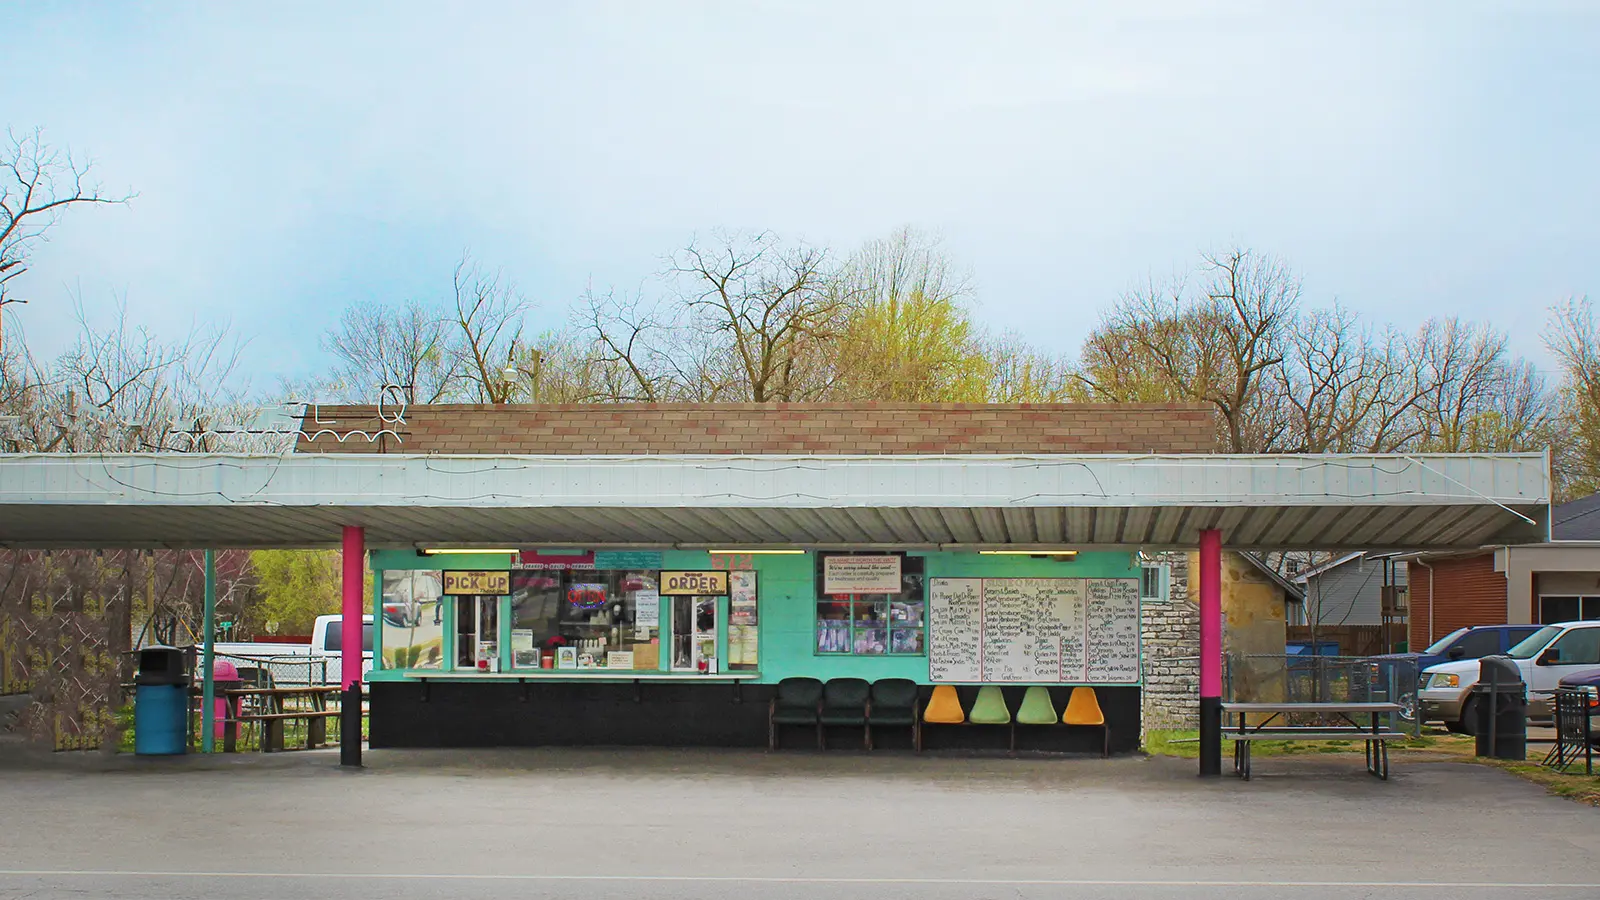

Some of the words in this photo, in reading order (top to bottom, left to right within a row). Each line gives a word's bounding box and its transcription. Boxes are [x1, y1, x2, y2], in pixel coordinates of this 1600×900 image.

[446, 576, 479, 589] PICK
[487, 577, 507, 589] UP
[668, 576, 718, 590] ORDER
[567, 589, 607, 603] OPEN
